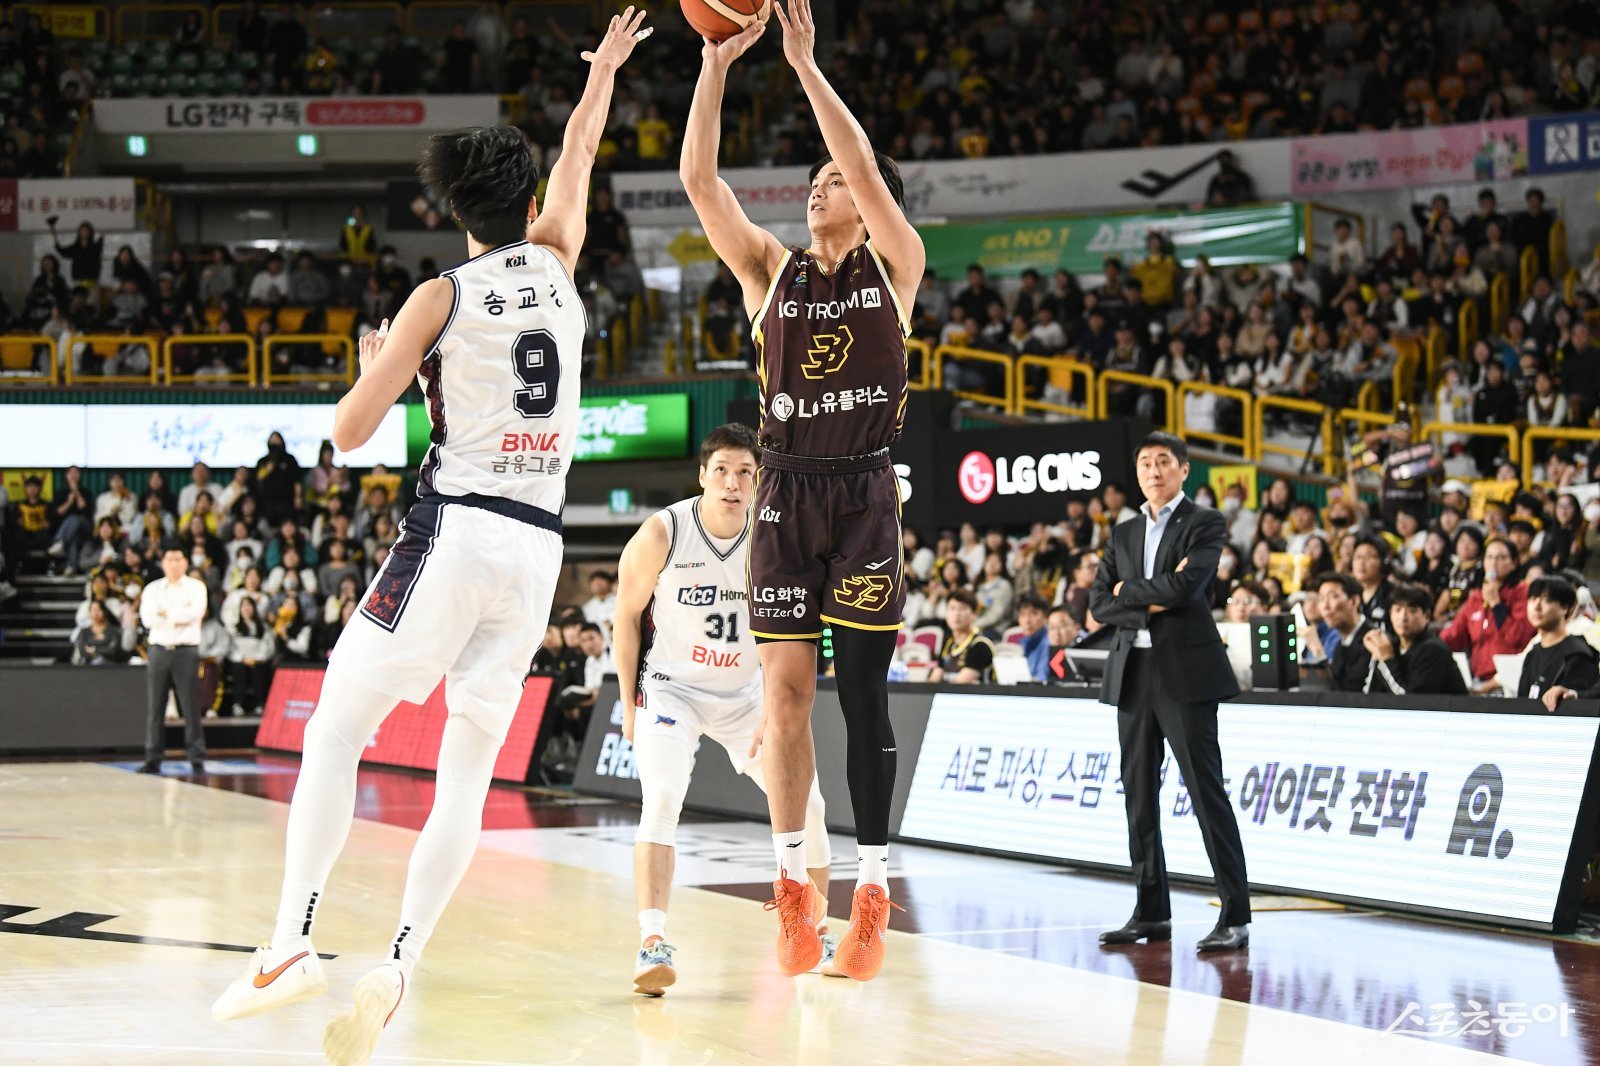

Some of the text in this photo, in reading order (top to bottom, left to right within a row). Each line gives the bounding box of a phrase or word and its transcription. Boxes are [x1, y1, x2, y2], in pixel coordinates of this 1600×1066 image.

[259, 103, 300, 126] 구독
[505, 254, 528, 268] KBL
[861, 287, 882, 309] AI
[511, 328, 562, 419] 9
[501, 432, 560, 452] BNK
[491, 454, 562, 476] 금융그룹
[995, 450, 1101, 495] LG CNS
[758, 505, 782, 523] KBL
[679, 587, 715, 606] KCC
[704, 611, 740, 644] 31
[691, 645, 742, 668] BNK
[1050, 752, 1112, 809] 스팸
[1239, 761, 1346, 834] 에이닷
[1349, 767, 1429, 842] 전화
